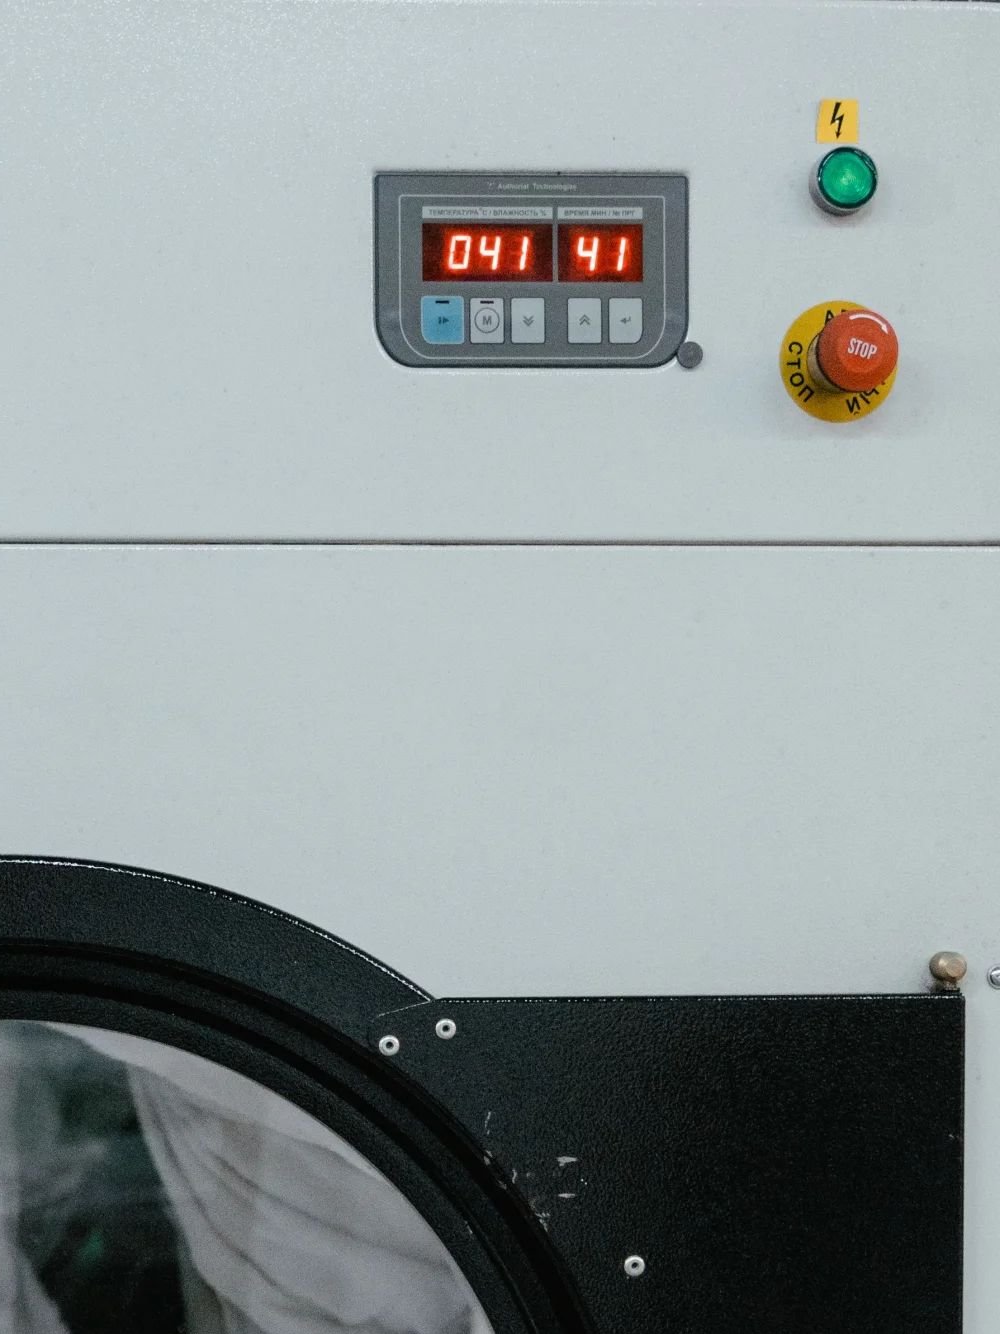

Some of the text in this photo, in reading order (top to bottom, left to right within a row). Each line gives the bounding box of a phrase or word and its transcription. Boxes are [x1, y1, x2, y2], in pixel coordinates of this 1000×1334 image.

[428, 209, 478, 217] ТЕМПЕРАТУРА
[492, 209, 538, 217] ВЛАЖНОСТЬ
[564, 209, 590, 217] ВРЕМЯ
[590, 209, 606, 217] МИН
[447, 234, 530, 271] 041
[576, 235, 628, 272] 41
[847, 337, 878, 360] STOP
[786, 341, 815, 403] СТОП
